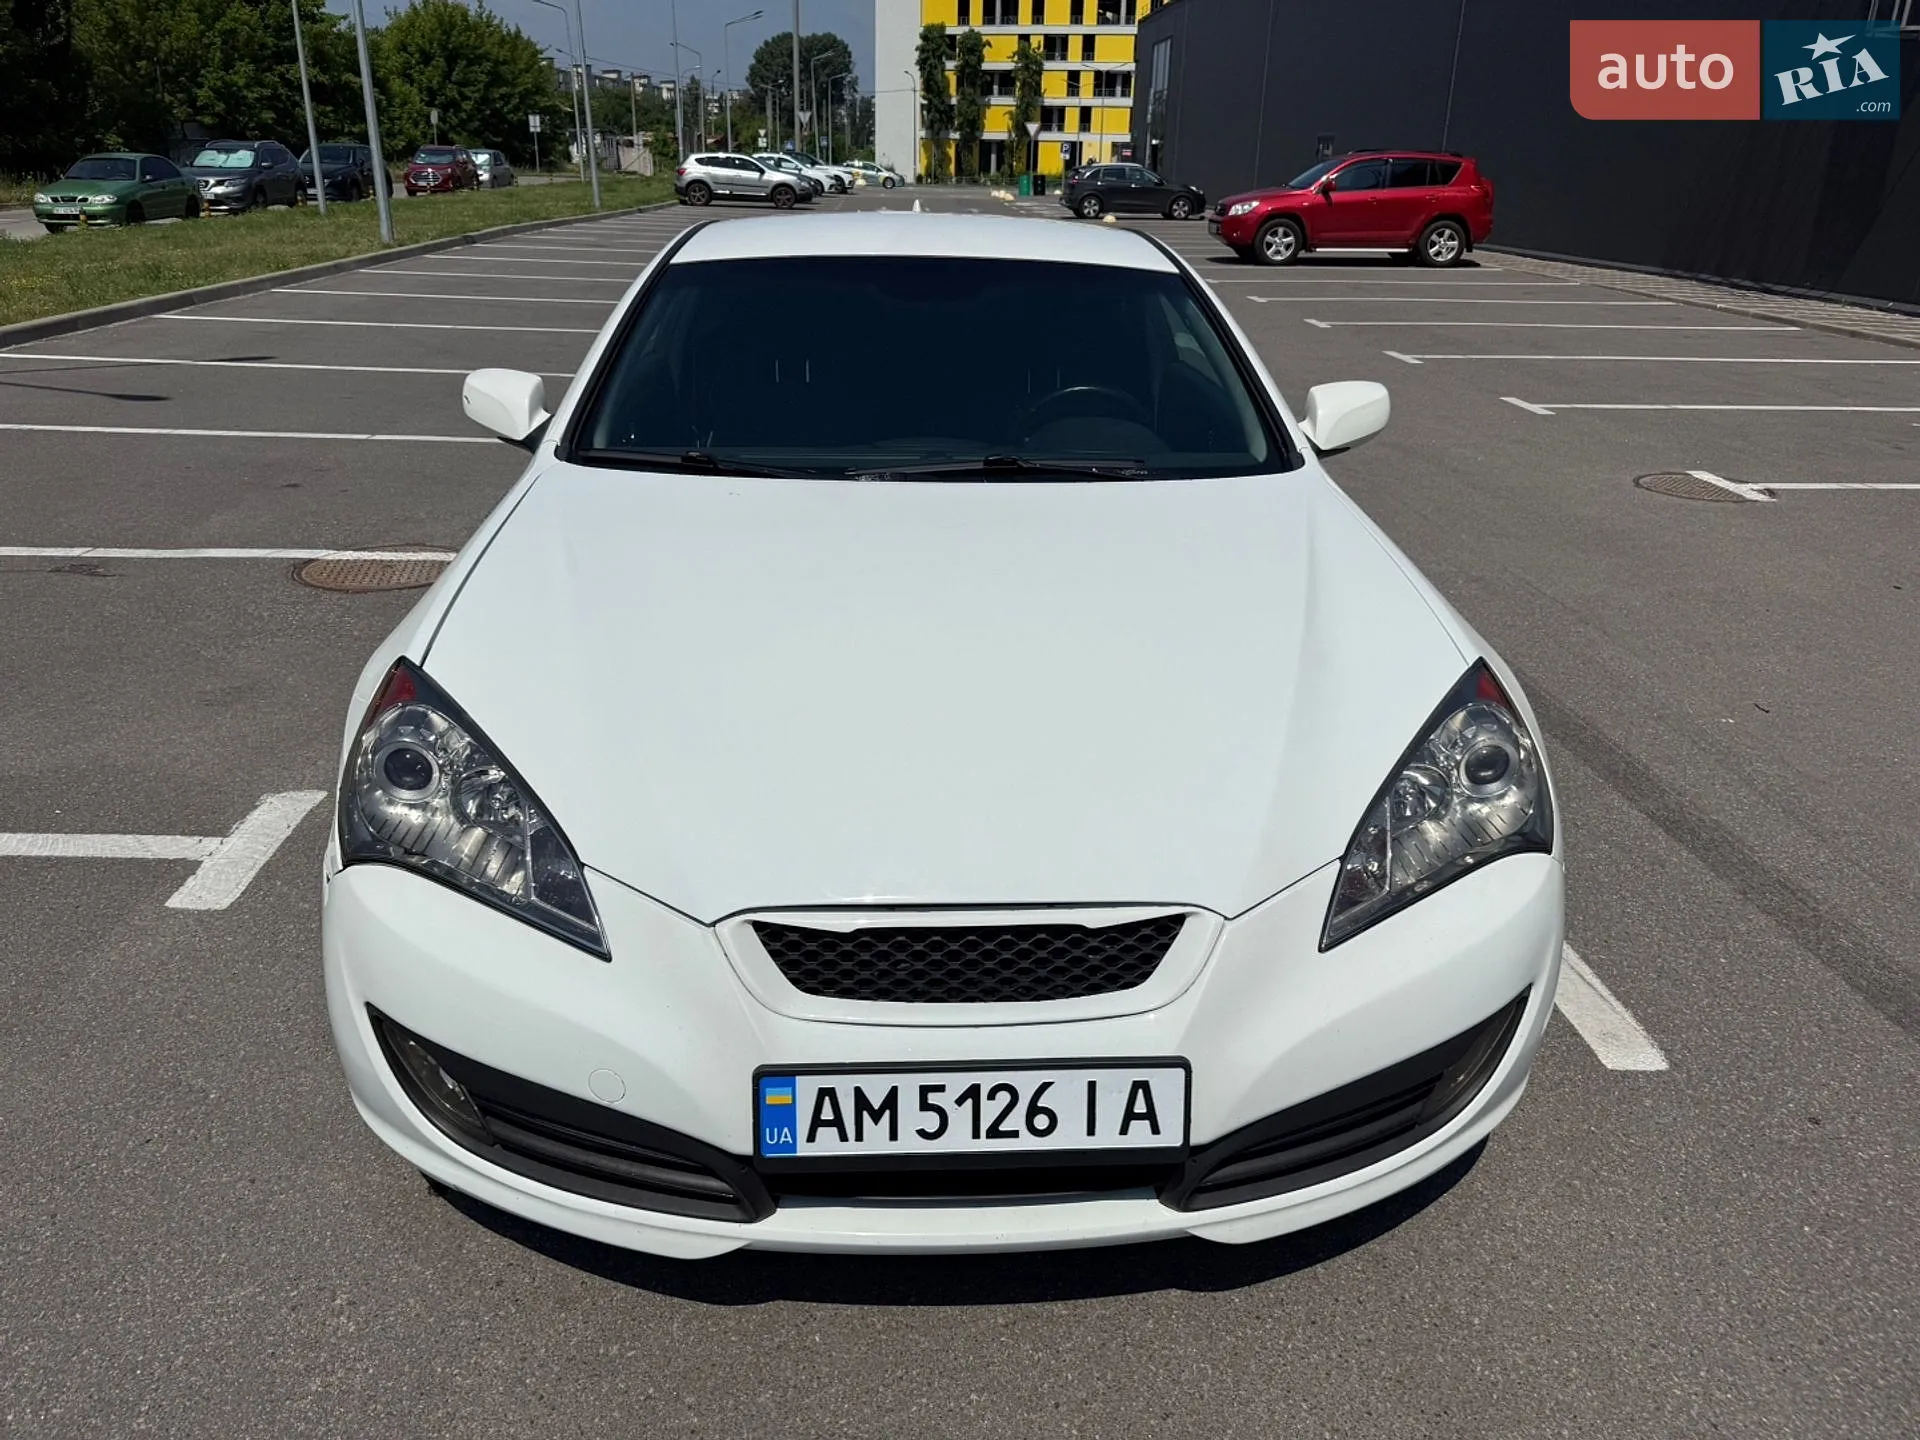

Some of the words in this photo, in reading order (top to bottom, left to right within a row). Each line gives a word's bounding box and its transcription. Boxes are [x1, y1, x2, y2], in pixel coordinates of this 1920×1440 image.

[805, 1085, 898, 1142] AM
[915, 1081, 1059, 1141] 5126
[766, 1127, 793, 1145] UA
